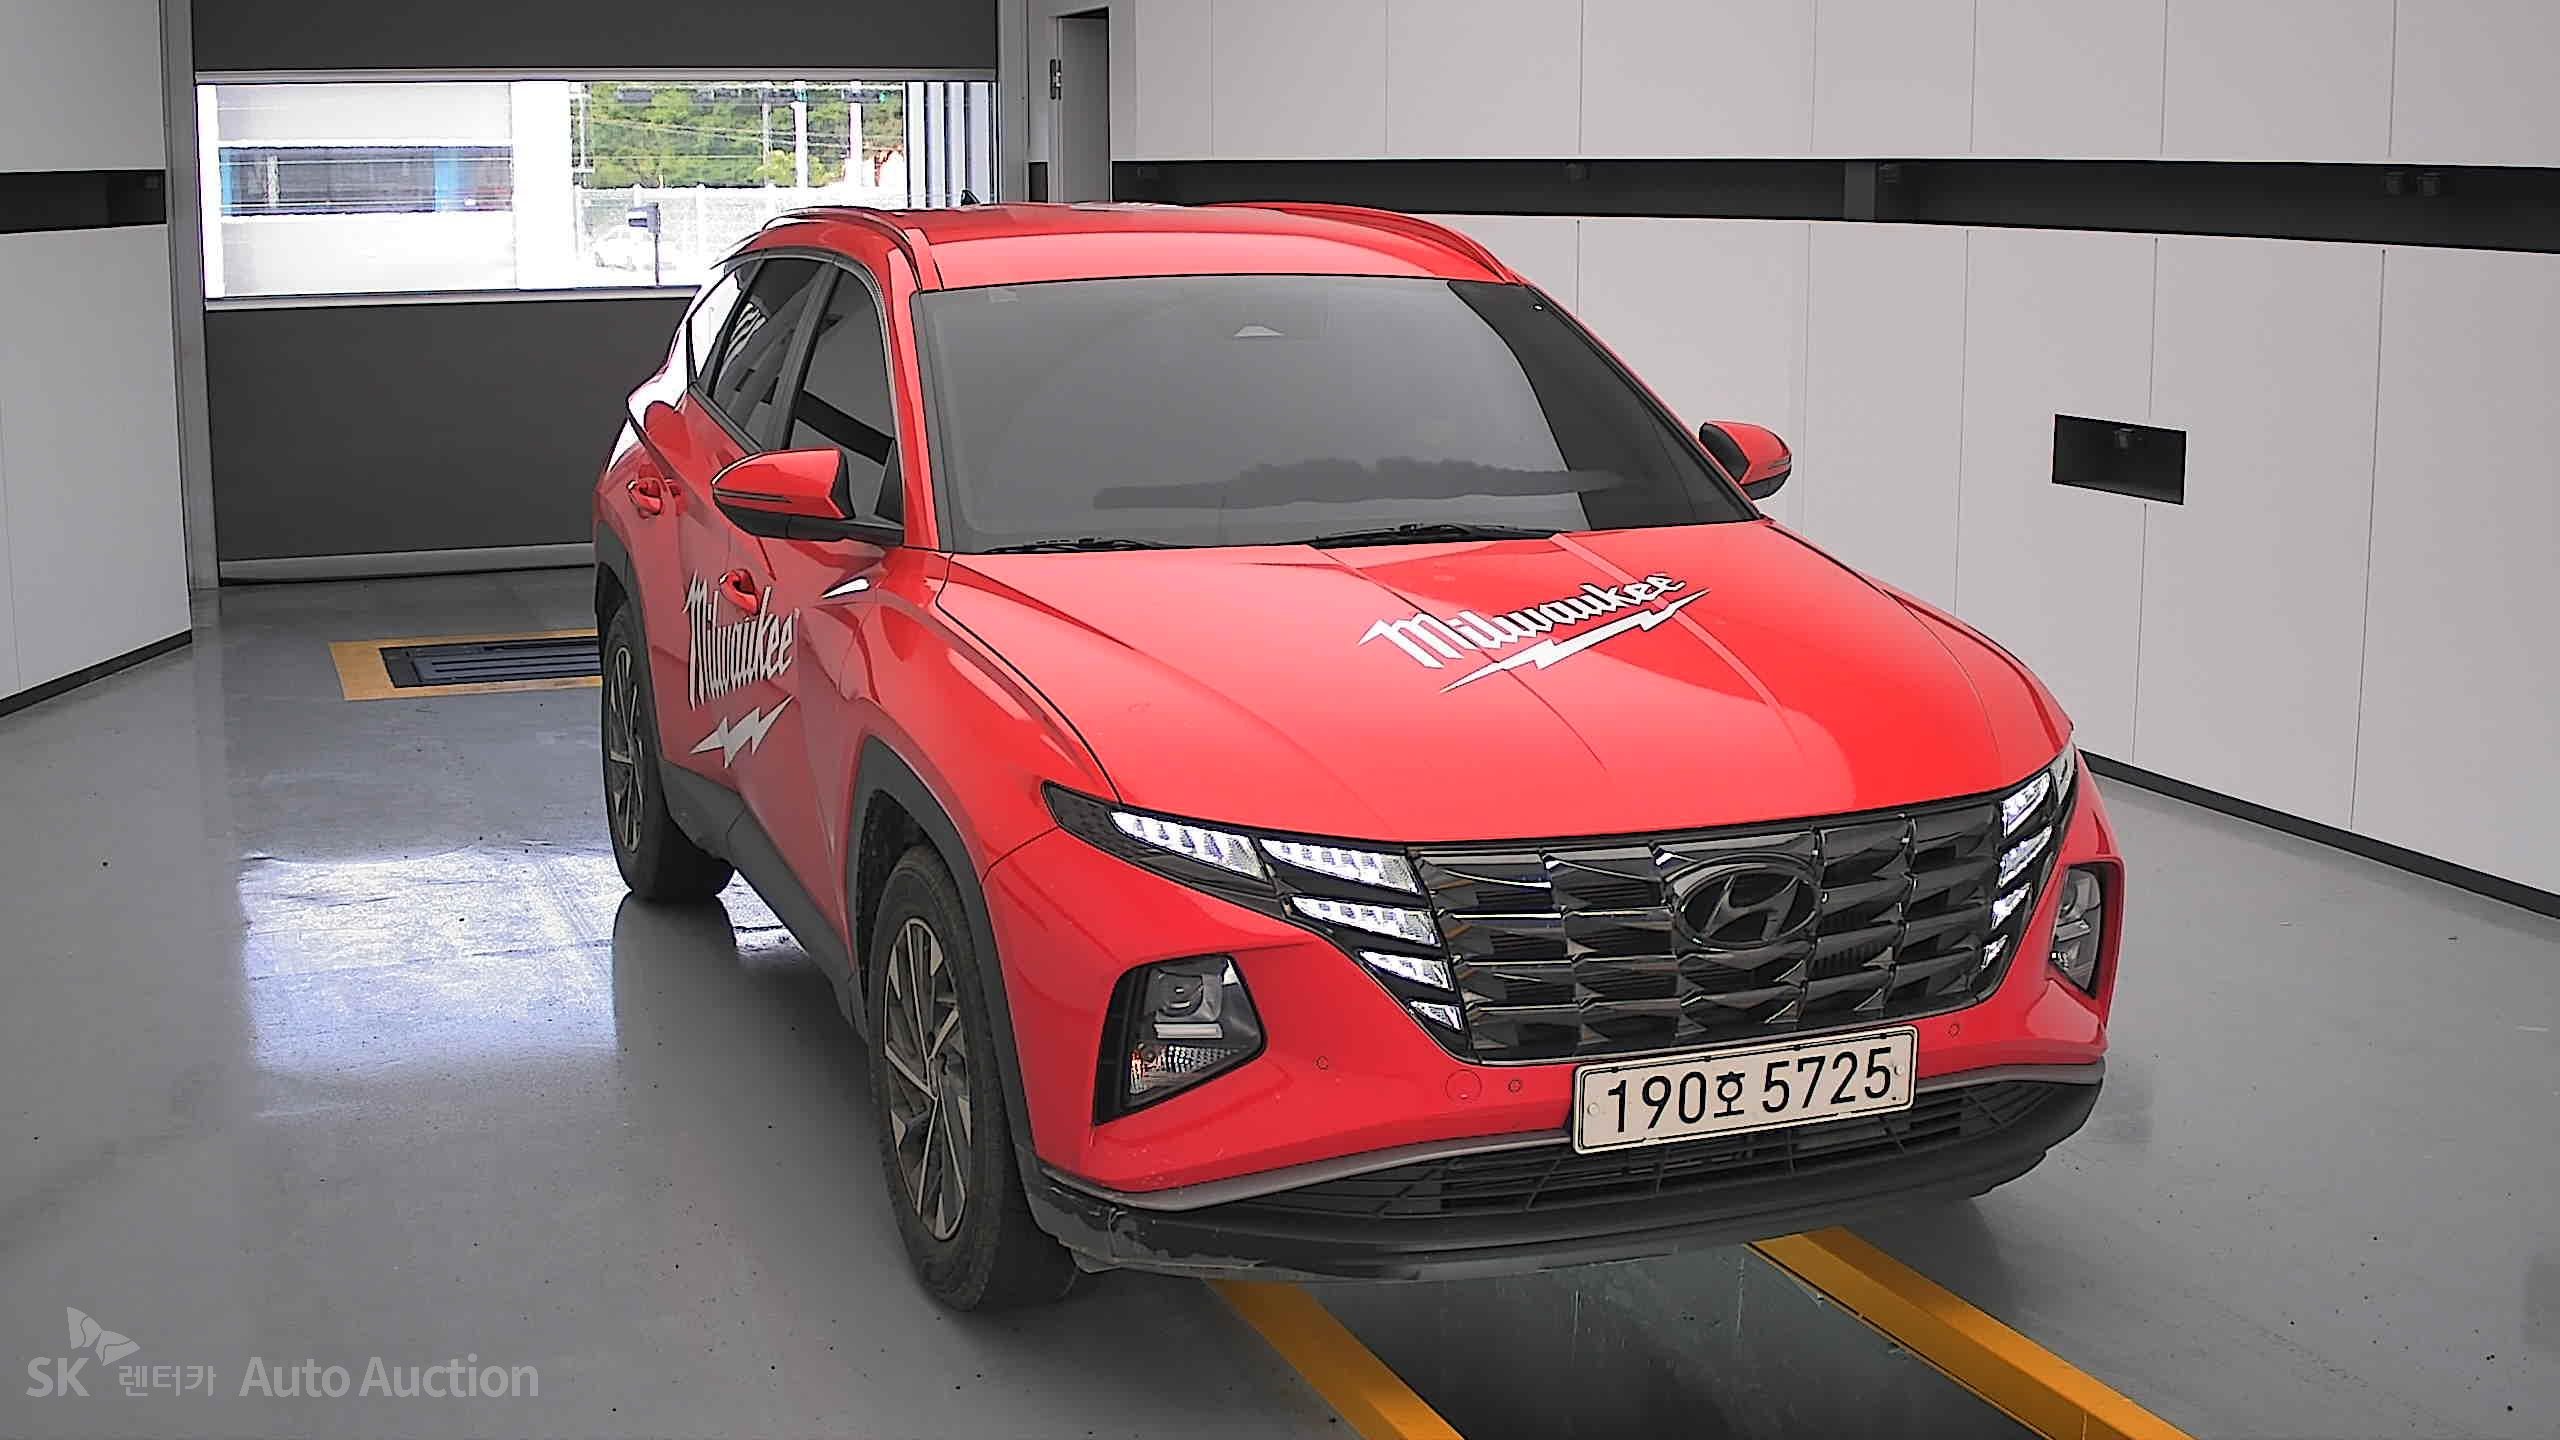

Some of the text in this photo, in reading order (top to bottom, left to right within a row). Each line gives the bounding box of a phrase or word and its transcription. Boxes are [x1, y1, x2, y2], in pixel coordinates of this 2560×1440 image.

[683, 569, 793, 711] Milwaukee
[1359, 573, 1686, 668] Milwaukee
[1608, 1047, 1891, 1133] 190호 5725
